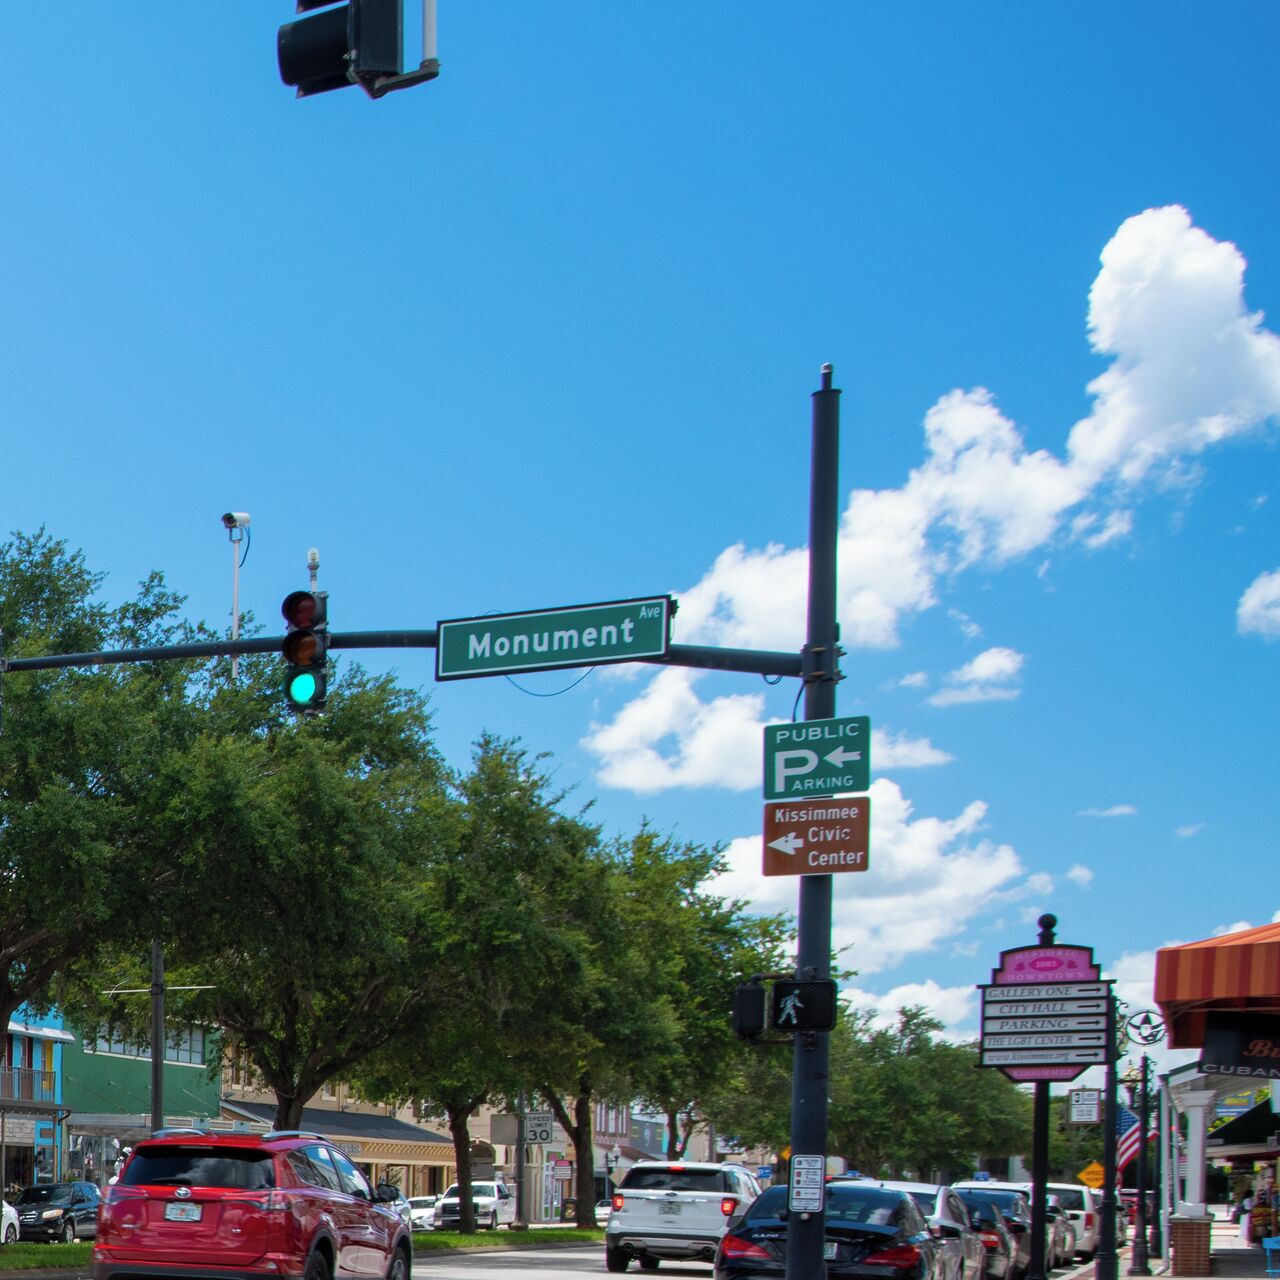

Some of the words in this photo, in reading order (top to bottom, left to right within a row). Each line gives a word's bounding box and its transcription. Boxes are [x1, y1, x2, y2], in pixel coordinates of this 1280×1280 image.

[639, 605, 661, 620] Ave
[468, 617, 634, 659] Monument
[775, 723, 860, 744] PUBLIC
[775, 807, 859, 823] Kissimmee
[808, 827, 851, 842] Civic
[808, 851, 864, 866] Center
[1015, 950, 1078, 960] HISTORIC
[1007, 972, 1086, 981] DOWNTOWN
[988, 988, 1043, 998] GALLERY
[1045, 987, 1072, 996] ONE
[1000, 1004, 1030, 1014] CITY
[1032, 1003, 1067, 1012] HALL
[1000, 1019, 1069, 1029] PARKING
[987, 1037, 1005, 1046] THE
[1007, 1036, 1033, 1046] LGBT
[1034, 1035, 1073, 1045] CENTER
[529, 1130, 550, 1141] 30
